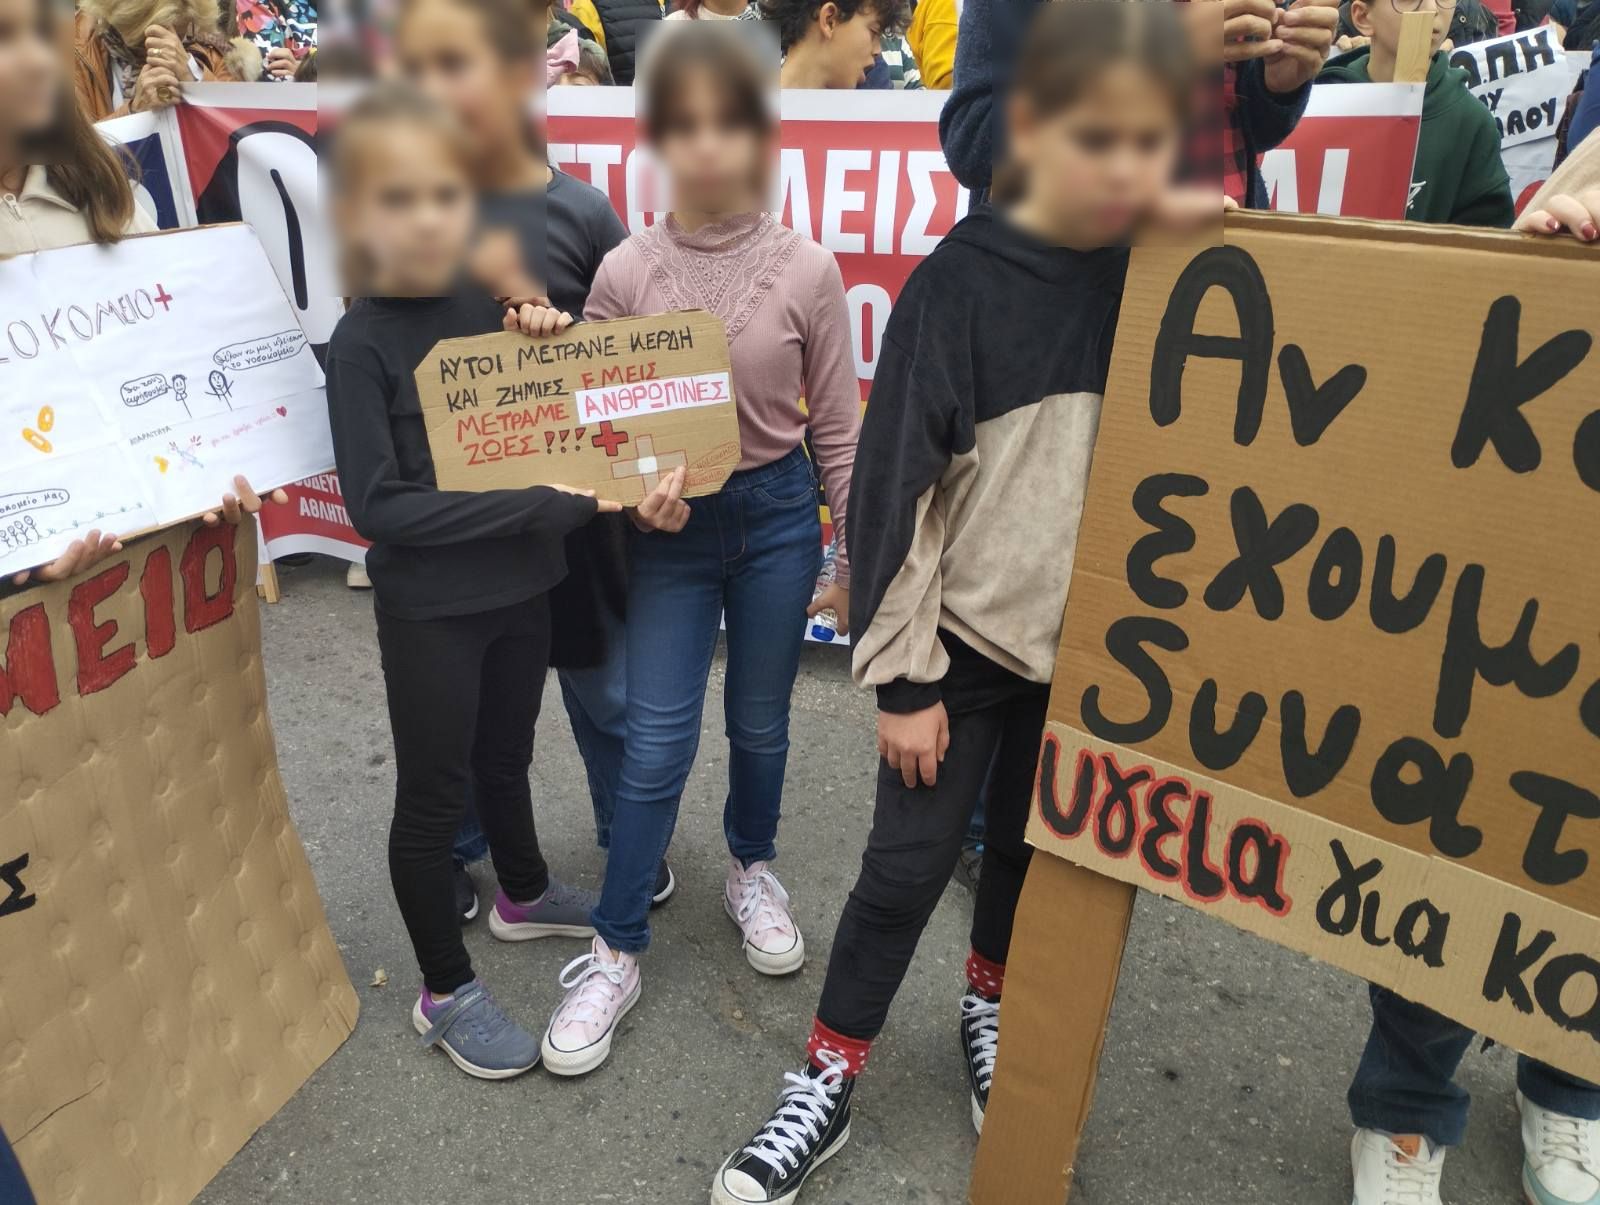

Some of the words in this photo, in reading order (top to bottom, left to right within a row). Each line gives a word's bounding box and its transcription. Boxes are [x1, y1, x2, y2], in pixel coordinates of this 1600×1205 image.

[0, 289, 155, 363] ΟΚΟΜΕΙΟ
[440, 353, 503, 384] ΑΥΤΟΙ
[517, 335, 619, 370] ΜΕΤΡΑΝΕ
[631, 326, 693, 353] ΚΕΡΔΗ
[1150, 246, 1367, 447] Αν
[446, 387, 479, 412] ΚΑΙ
[496, 378, 569, 407] ΖΗΜΙΕΣ
[581, 362, 661, 390] ΕΜΕΙΣ
[456, 402, 569, 442] ΜΕΤΡΑΜΕ
[1126, 472, 1600, 740] εχουμ
[1315, 839, 1450, 969] για
